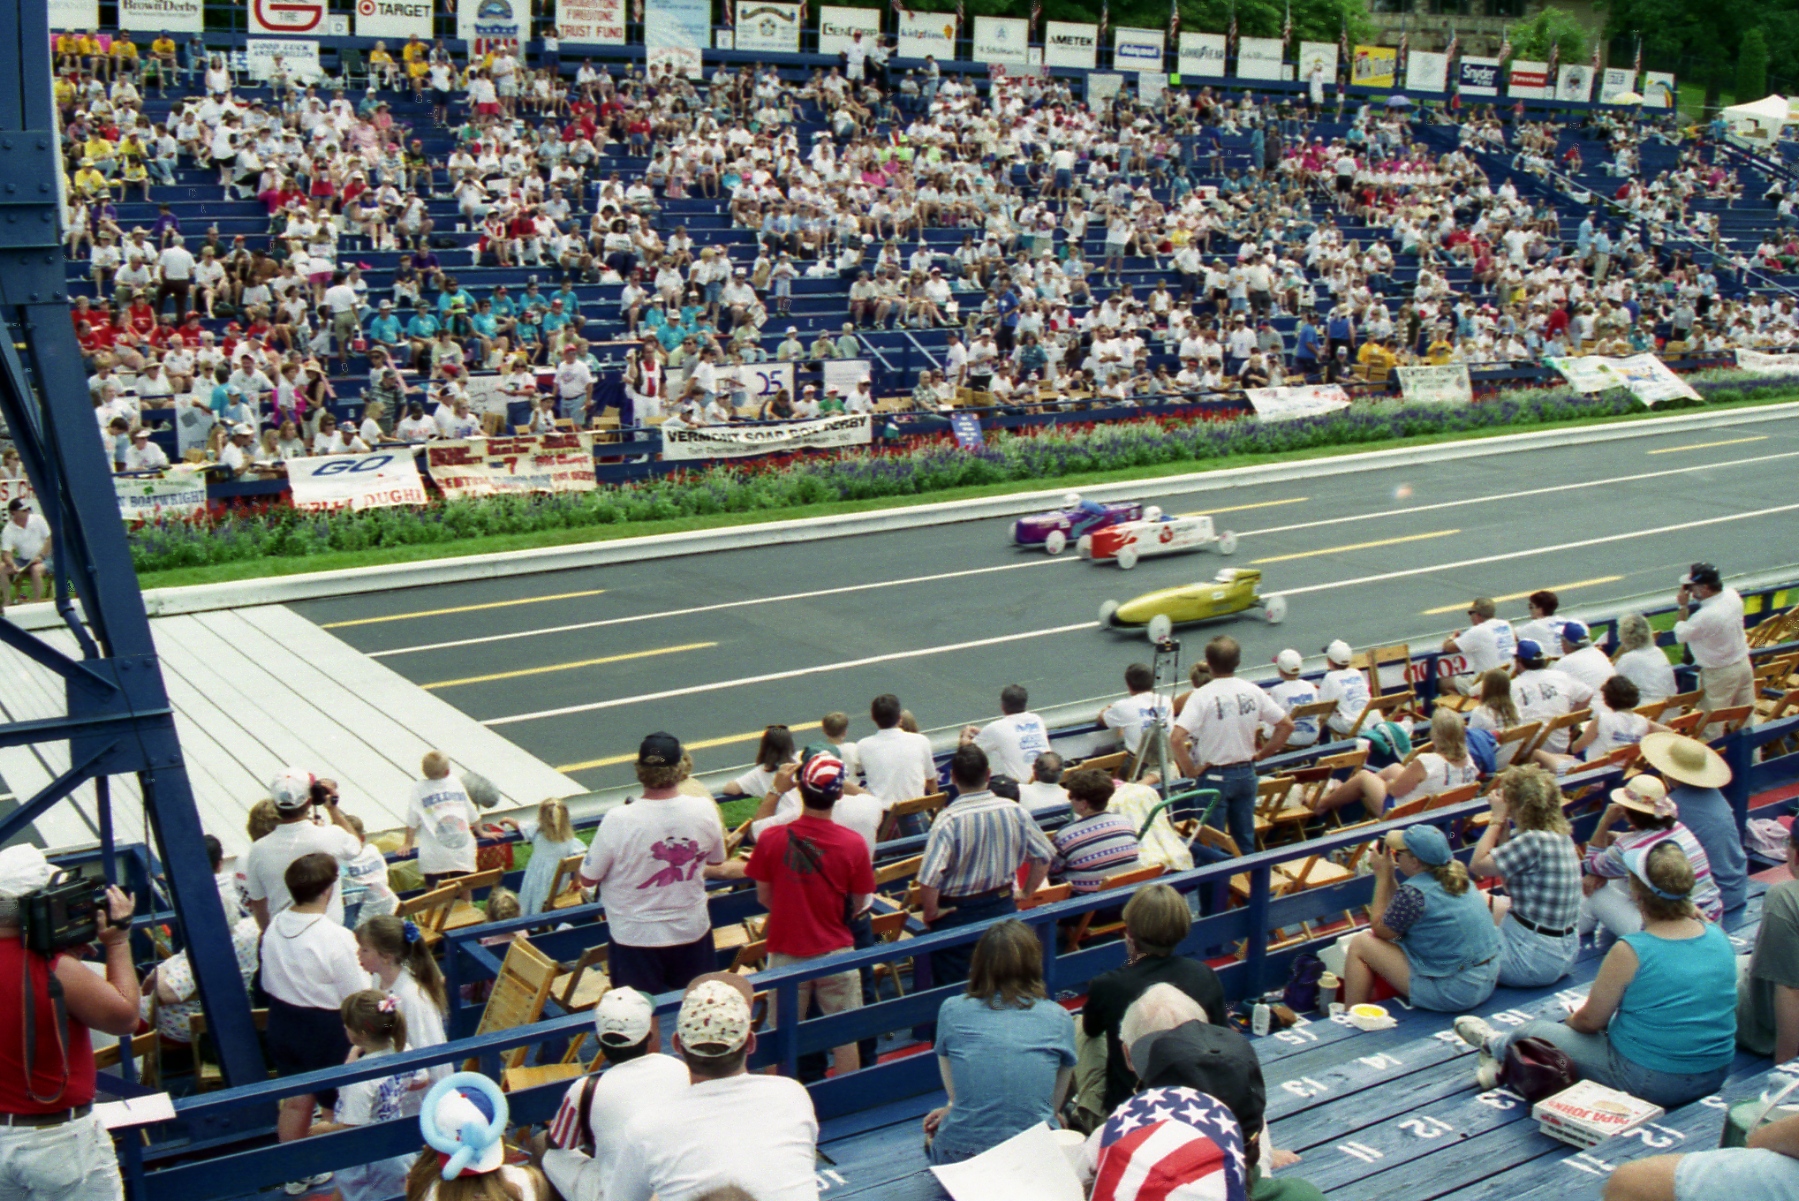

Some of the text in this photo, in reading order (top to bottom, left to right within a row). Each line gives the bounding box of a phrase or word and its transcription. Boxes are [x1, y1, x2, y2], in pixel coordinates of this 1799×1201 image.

[377, 2, 432, 17] TARGET
[560, 24, 623, 38] TRUST FUND
[1049, 35, 1094, 46] AMETEK
[1462, 65, 1497, 82] Snyder
[667, 430, 739, 443] VERMONT
[823, 416, 867, 431] DERBY
[311, 455, 394, 476] GO
[1399, 1116, 1453, 1138] 12
[1594, 1112, 1631, 1125] PAPA
[1622, 1122, 1687, 1148] 12
[1337, 1141, 1384, 1163] 11
